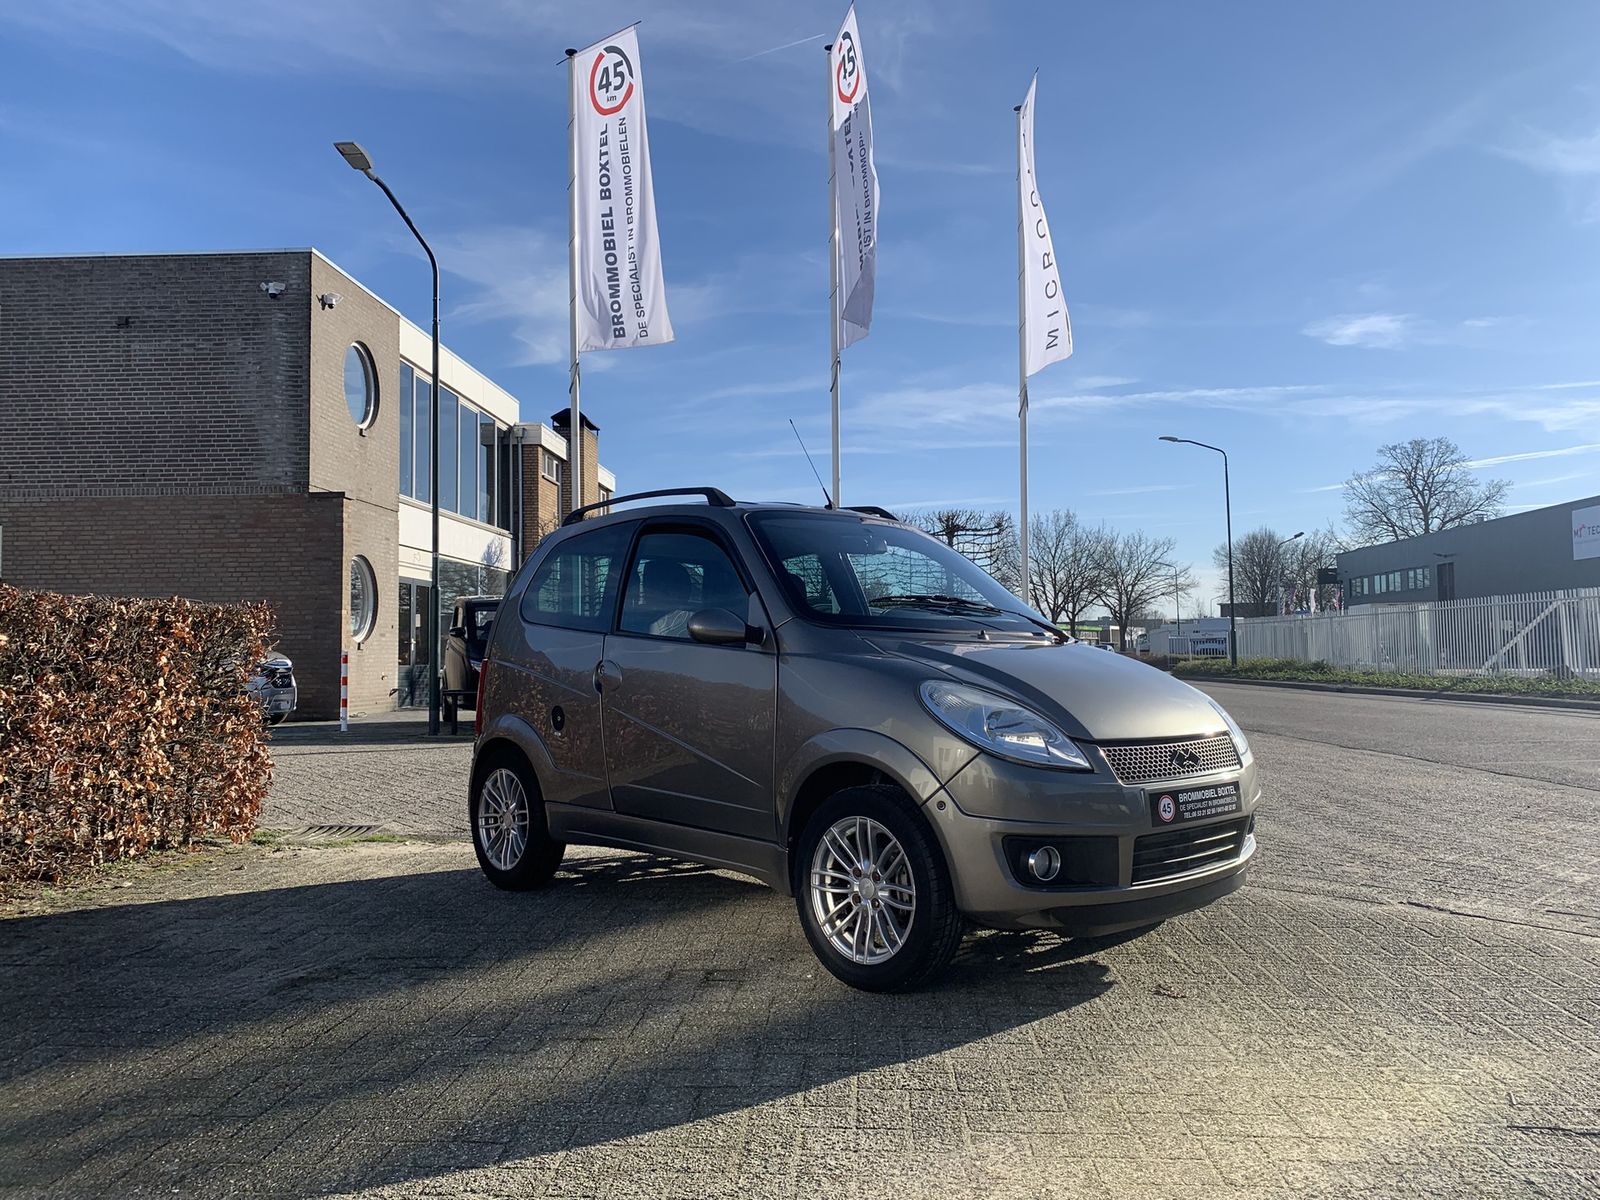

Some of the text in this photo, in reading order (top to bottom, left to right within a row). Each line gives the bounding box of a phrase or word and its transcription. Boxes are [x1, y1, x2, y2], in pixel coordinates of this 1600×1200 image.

[598, 60, 625, 94] 45
[599, 123, 626, 338] BROMMOBIEL BOXTEL
[619, 117, 649, 338] DE SPECIALIST IN BROMMOBIELEN
[1162, 803, 1172, 814] 45
[1179, 785, 1236, 803] BROMMOBIEL BOXTEL
